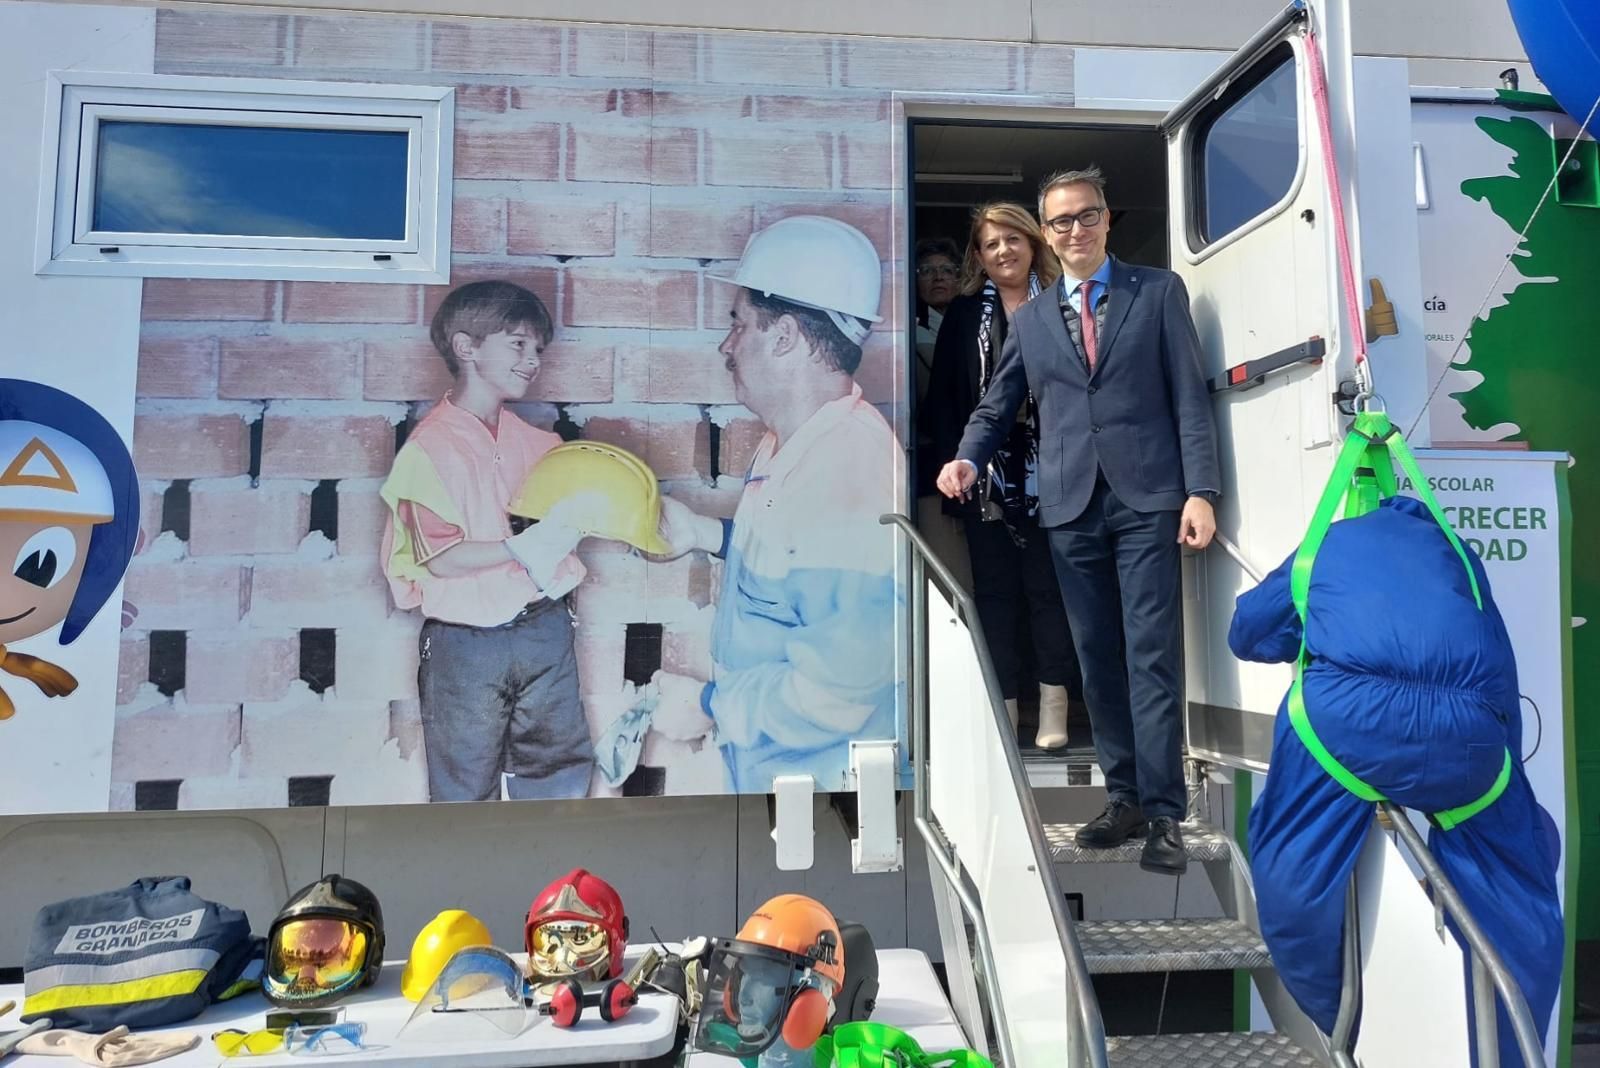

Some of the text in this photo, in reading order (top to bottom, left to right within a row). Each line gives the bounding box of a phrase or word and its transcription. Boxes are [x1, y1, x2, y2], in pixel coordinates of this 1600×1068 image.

[1424, 477, 1494, 491] SCOLAR
[1442, 507, 1547, 530] CRECER
[75, 915, 193, 940] BOMBEROS
[76, 929, 179, 951] GRANADA
